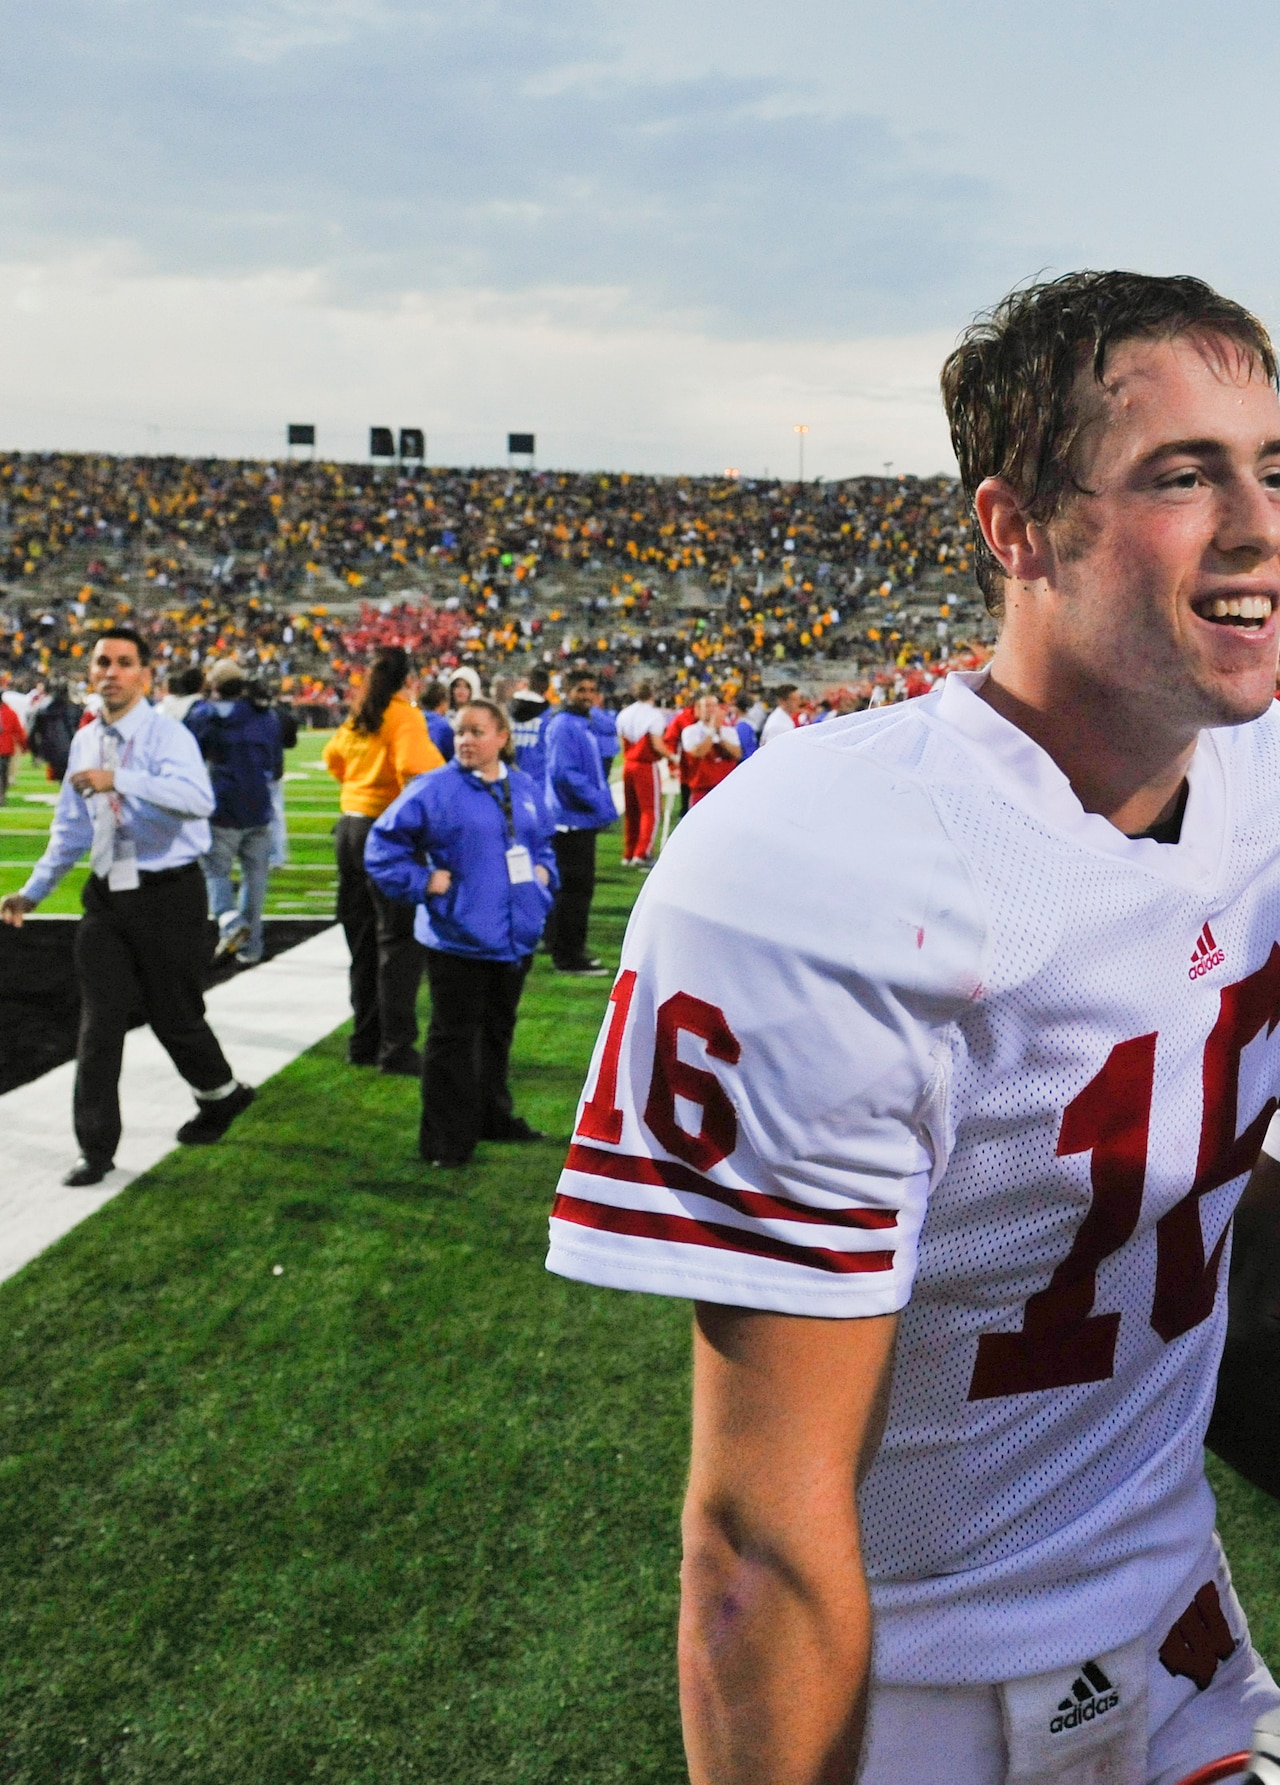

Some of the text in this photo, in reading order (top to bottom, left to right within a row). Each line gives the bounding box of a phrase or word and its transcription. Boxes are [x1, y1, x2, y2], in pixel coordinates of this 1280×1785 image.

[1188, 948, 1226, 981] adidas
[576, 969, 741, 1172] 16
[1050, 1690, 1119, 1734] adidas
